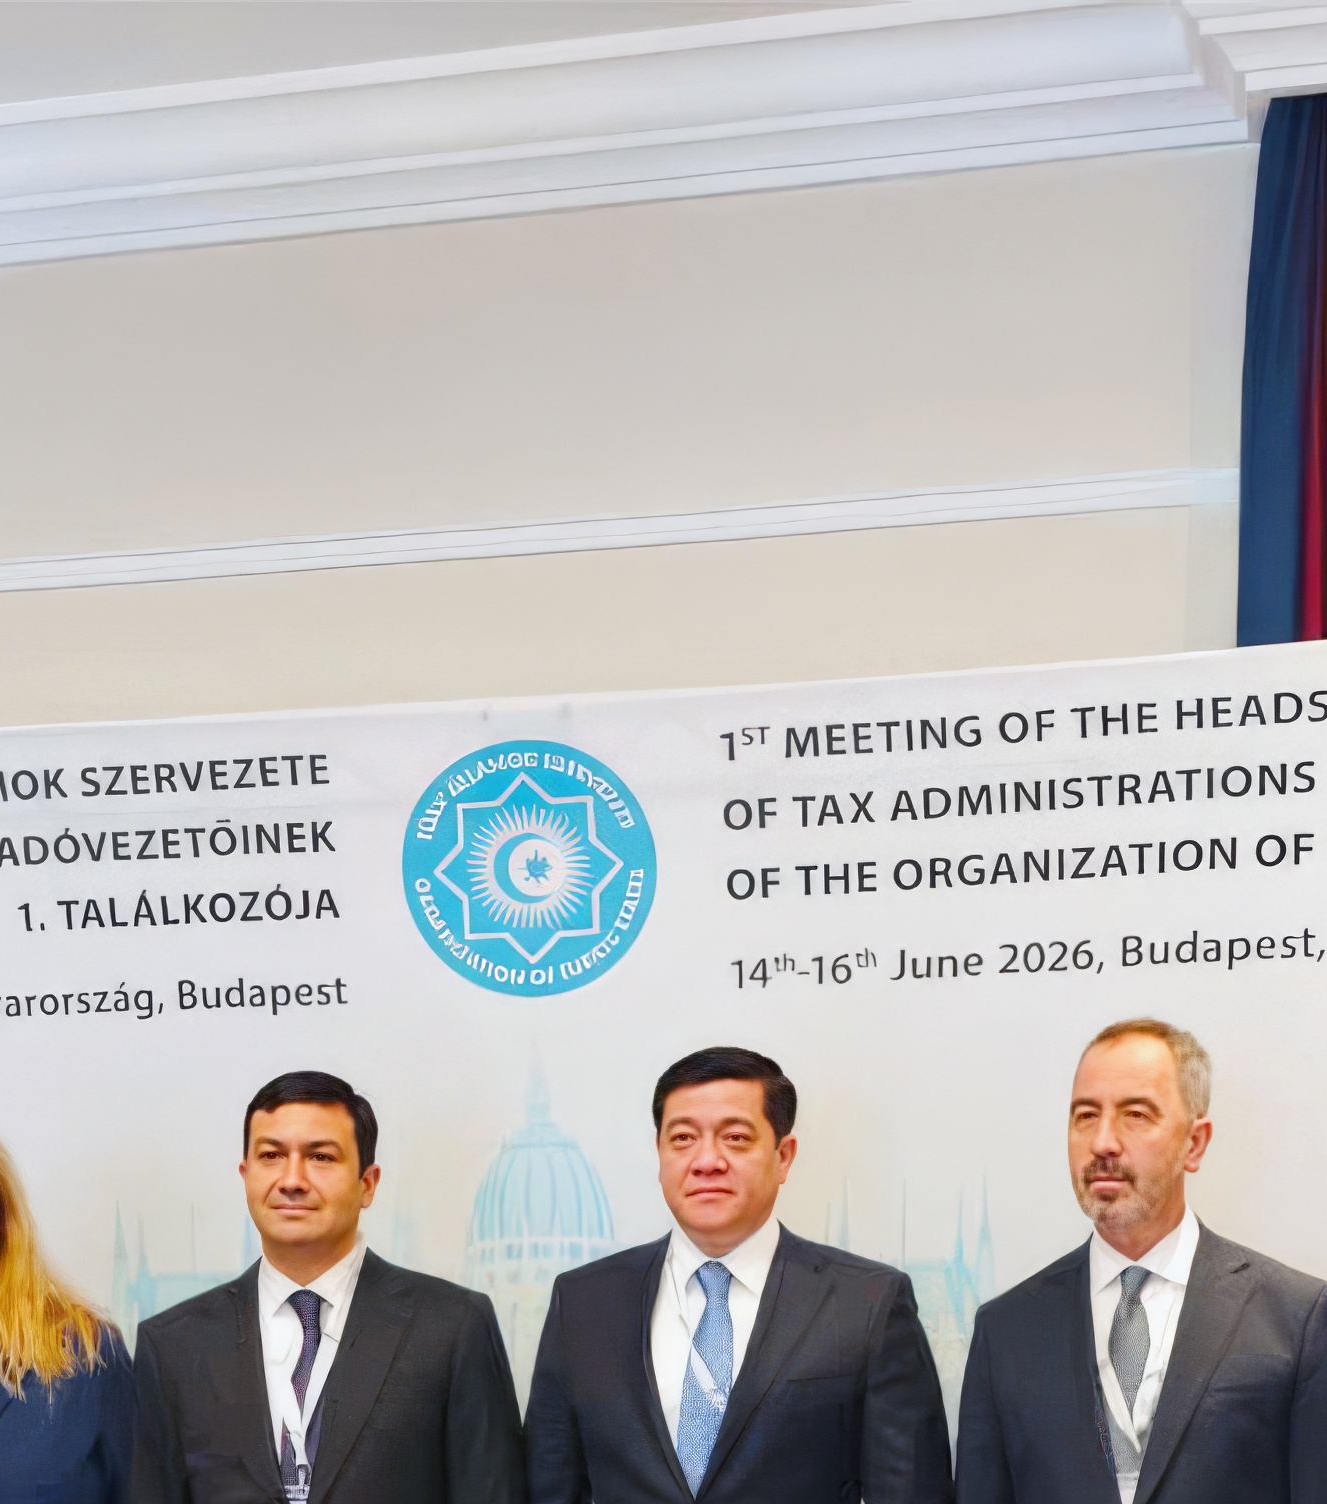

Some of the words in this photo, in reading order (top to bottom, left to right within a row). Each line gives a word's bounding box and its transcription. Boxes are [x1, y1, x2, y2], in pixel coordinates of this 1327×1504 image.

[718, 724, 772, 763] 1ST
[783, 714, 984, 760] MEETING
[997, 707, 1057, 745] OF
[1068, 701, 1160, 740] THE
[79, 753, 331, 799] SZERVEZETE
[722, 796, 779, 832] OF
[790, 789, 877, 829] TAX
[888, 759, 1317, 823] ADMINISTRATIONS
[725, 865, 782, 902] OF
[793, 860, 879, 897] THE
[891, 835, 1239, 892] ORGANIZATION
[1254, 832, 1316, 869] OF
[16, 901, 47, 933] 1.
[55, 882, 342, 932] TALÁLKOZÓJA
[888, 948, 985, 982] June
[997, 938, 1105, 976] 2026,
[1120, 926, 1327, 972] Budapest,
[176, 976, 350, 1017] Budapest
